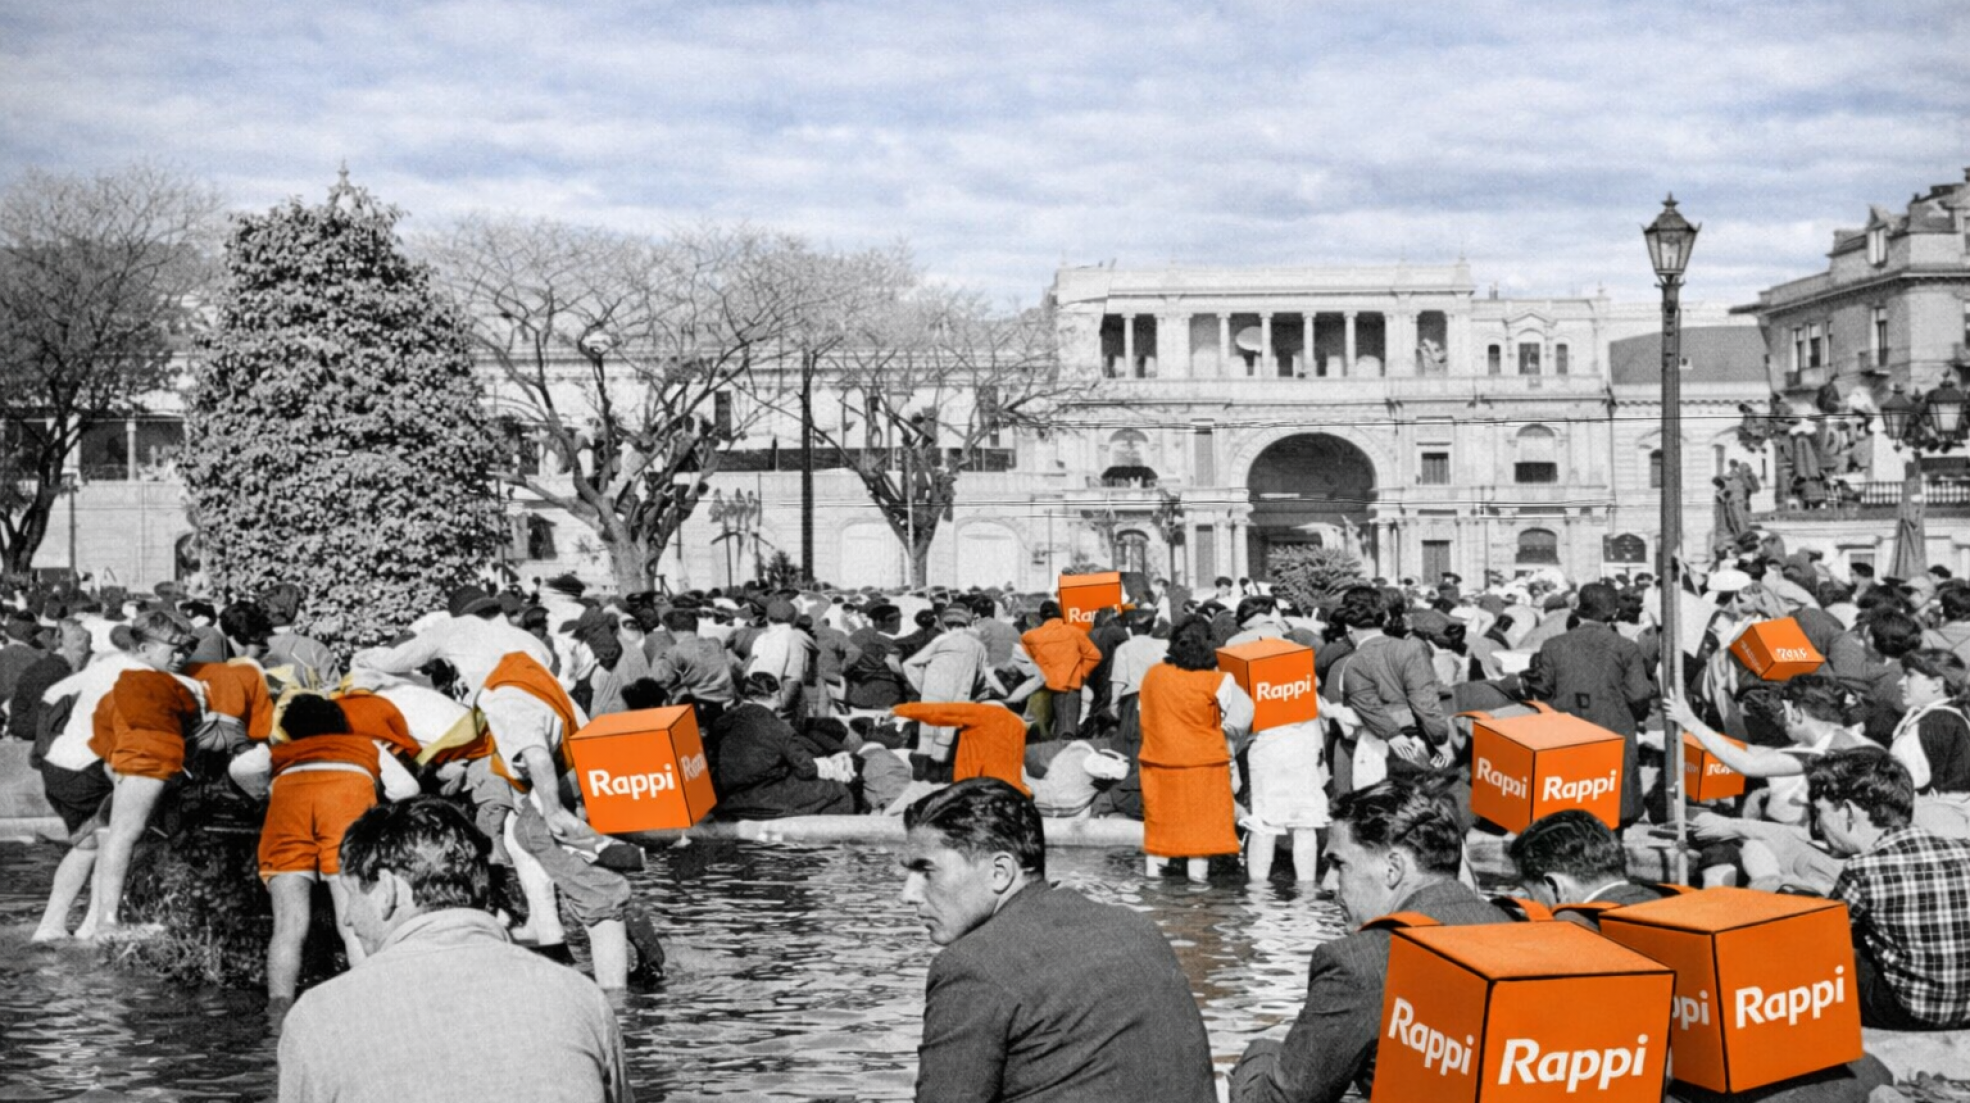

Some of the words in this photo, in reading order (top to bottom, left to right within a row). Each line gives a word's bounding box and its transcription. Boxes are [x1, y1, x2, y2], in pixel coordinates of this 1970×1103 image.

[1256, 674, 1312, 702] Rappi
[588, 763, 675, 800] Rappi
[1542, 769, 1617, 803] Rappi
[1735, 965, 1845, 1029] Rappi
[1388, 997, 1474, 1076] Rappi
[1498, 1034, 1649, 1093] Rappi
